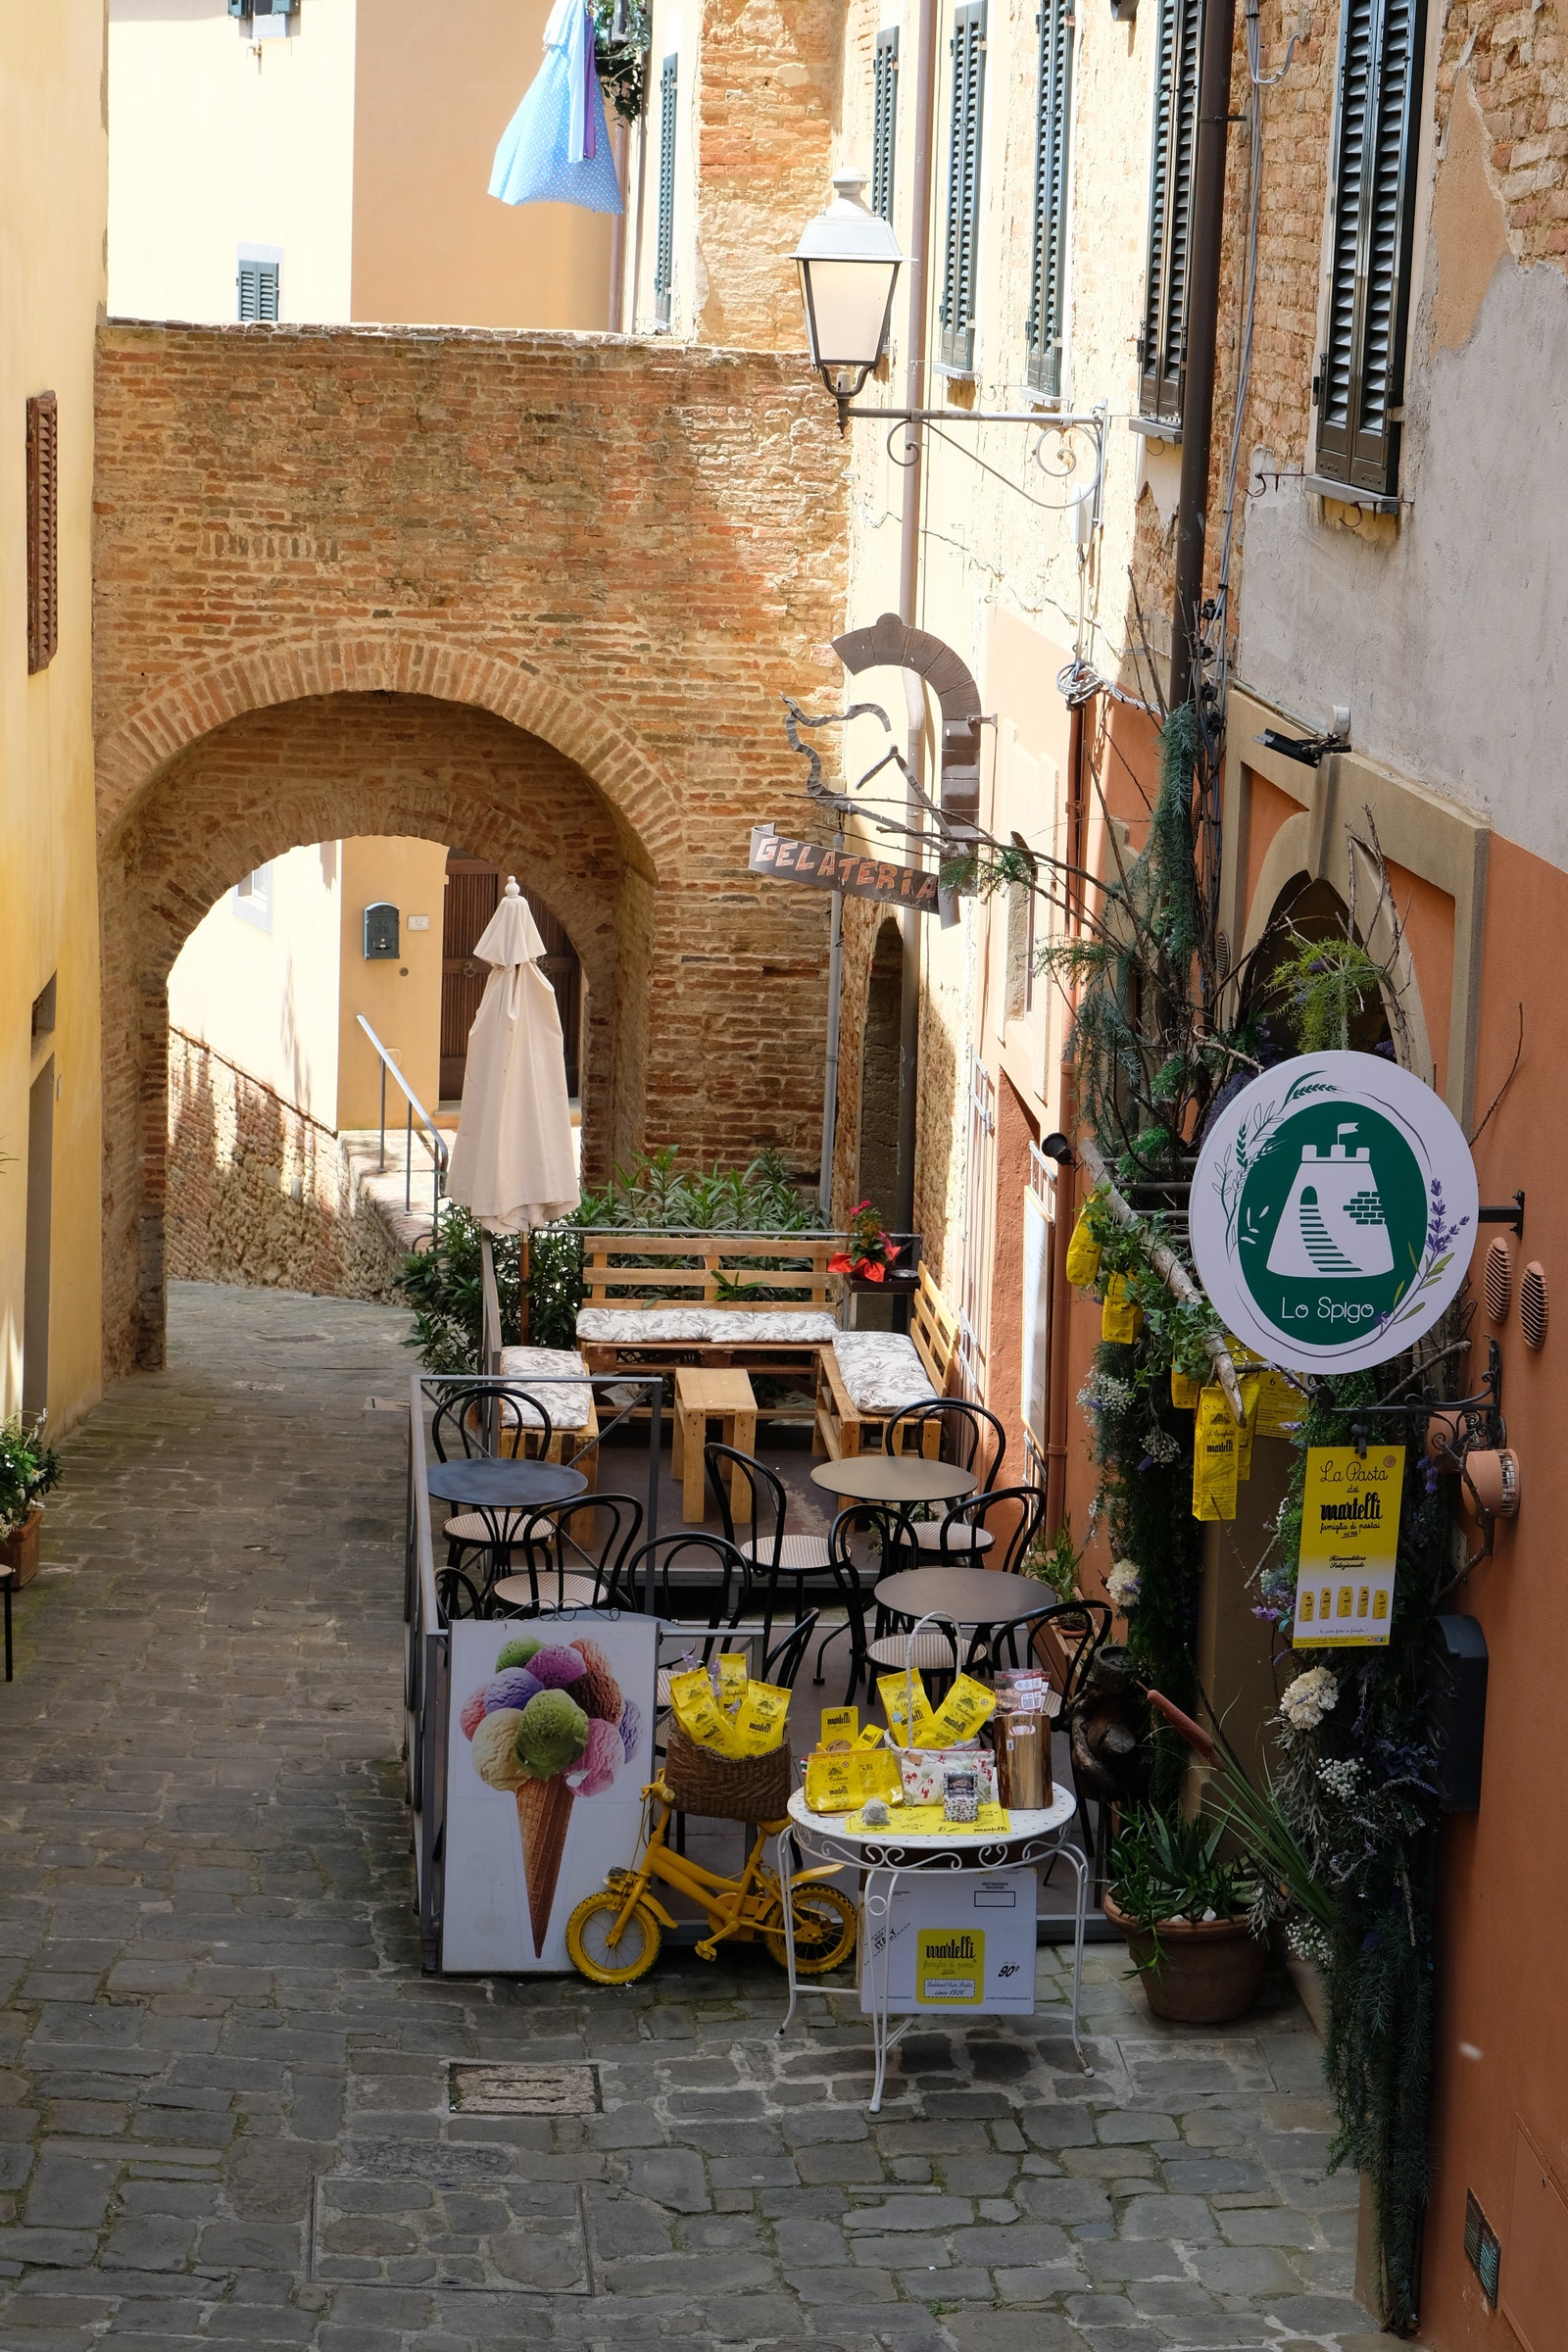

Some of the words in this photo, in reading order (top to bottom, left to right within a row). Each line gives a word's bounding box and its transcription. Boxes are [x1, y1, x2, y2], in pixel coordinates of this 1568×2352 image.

[415, 917, 423, 927] 12
[1281, 1297, 1309, 1319] Lo
[1317, 1296, 1374, 1324] Spigo
[1206, 1439, 1234, 1452] martelli
[1320, 1460, 1344, 1483] La
[1346, 1460, 1389, 1482] Pasta
[1347, 1484, 1359, 1494] dei
[1320, 1492, 1384, 1521] martelli
[1319, 1522, 1348, 1535] famiglia
[1349, 1521, 1356, 1530] di
[1358, 1522, 1381, 1534] pastai
[827, 1712, 851, 1725] martelli
[943, 1715, 967, 1734] martelli
[749, 1722, 772, 1734] martelli
[925, 1936, 976, 1960] martelli
